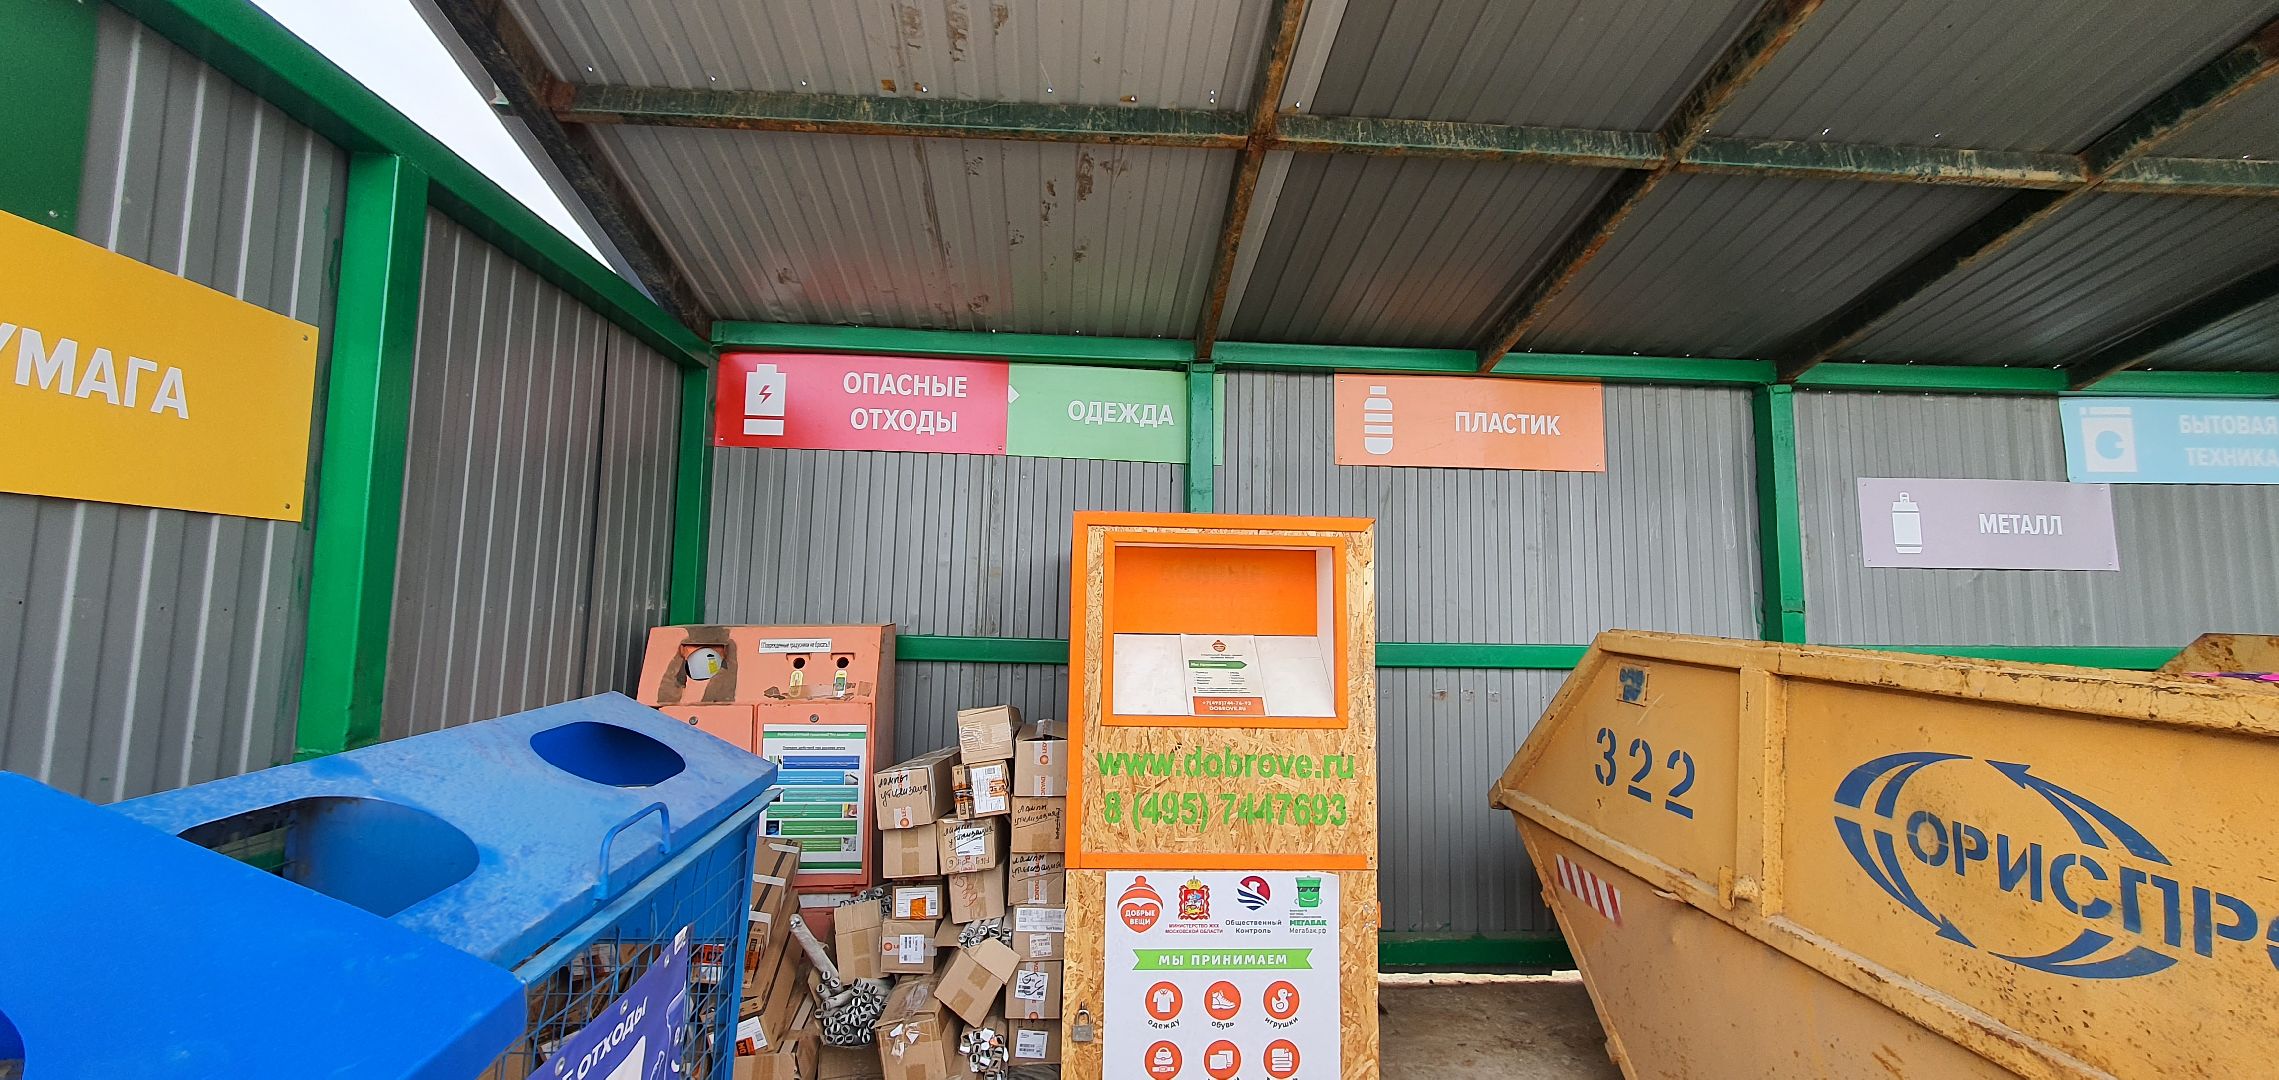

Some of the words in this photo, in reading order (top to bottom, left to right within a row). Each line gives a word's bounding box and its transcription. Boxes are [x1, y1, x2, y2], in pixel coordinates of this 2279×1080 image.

[843, 371, 967, 399] ОПАСНЫЕ
[850, 407, 957, 435] ОТХОДЫ
[1067, 400, 1174, 428] ОДЕЖДА
[1455, 411, 1560, 436] ПЛАСТИК
[2179, 413, 2278, 435] БЫТОВАЯ
[2185, 446, 2279, 467] ТЕХНИКА
[1978, 513, 2063, 536] МЕТАЛЛ
[1098, 744, 1355, 779] www.dobrove.ru
[1594, 727, 1696, 819] 322
[1104, 792, 1121, 824] 8
[1132, 791, 1209, 833] (495)
[1220, 792, 1348, 826] 7447693
[1906, 810, 2279, 971] ОРИСПР
[1125, 909, 1156, 917] ДОБРЫЕ
[1129, 918, 1151, 926] ВЕЩИ
[1225, 919, 1282, 927] Общественный
[1158, 954, 1184, 966] МЫ
[1191, 953, 1288, 966] ПРИНИМАЕМ
[1147, 1019, 1181, 1030] одежду
[1211, 1020, 1235, 1030] обувь
[1264, 1016, 1299, 1030] игрушки
[577, 996, 648, 1080] ОТХОДЫ
